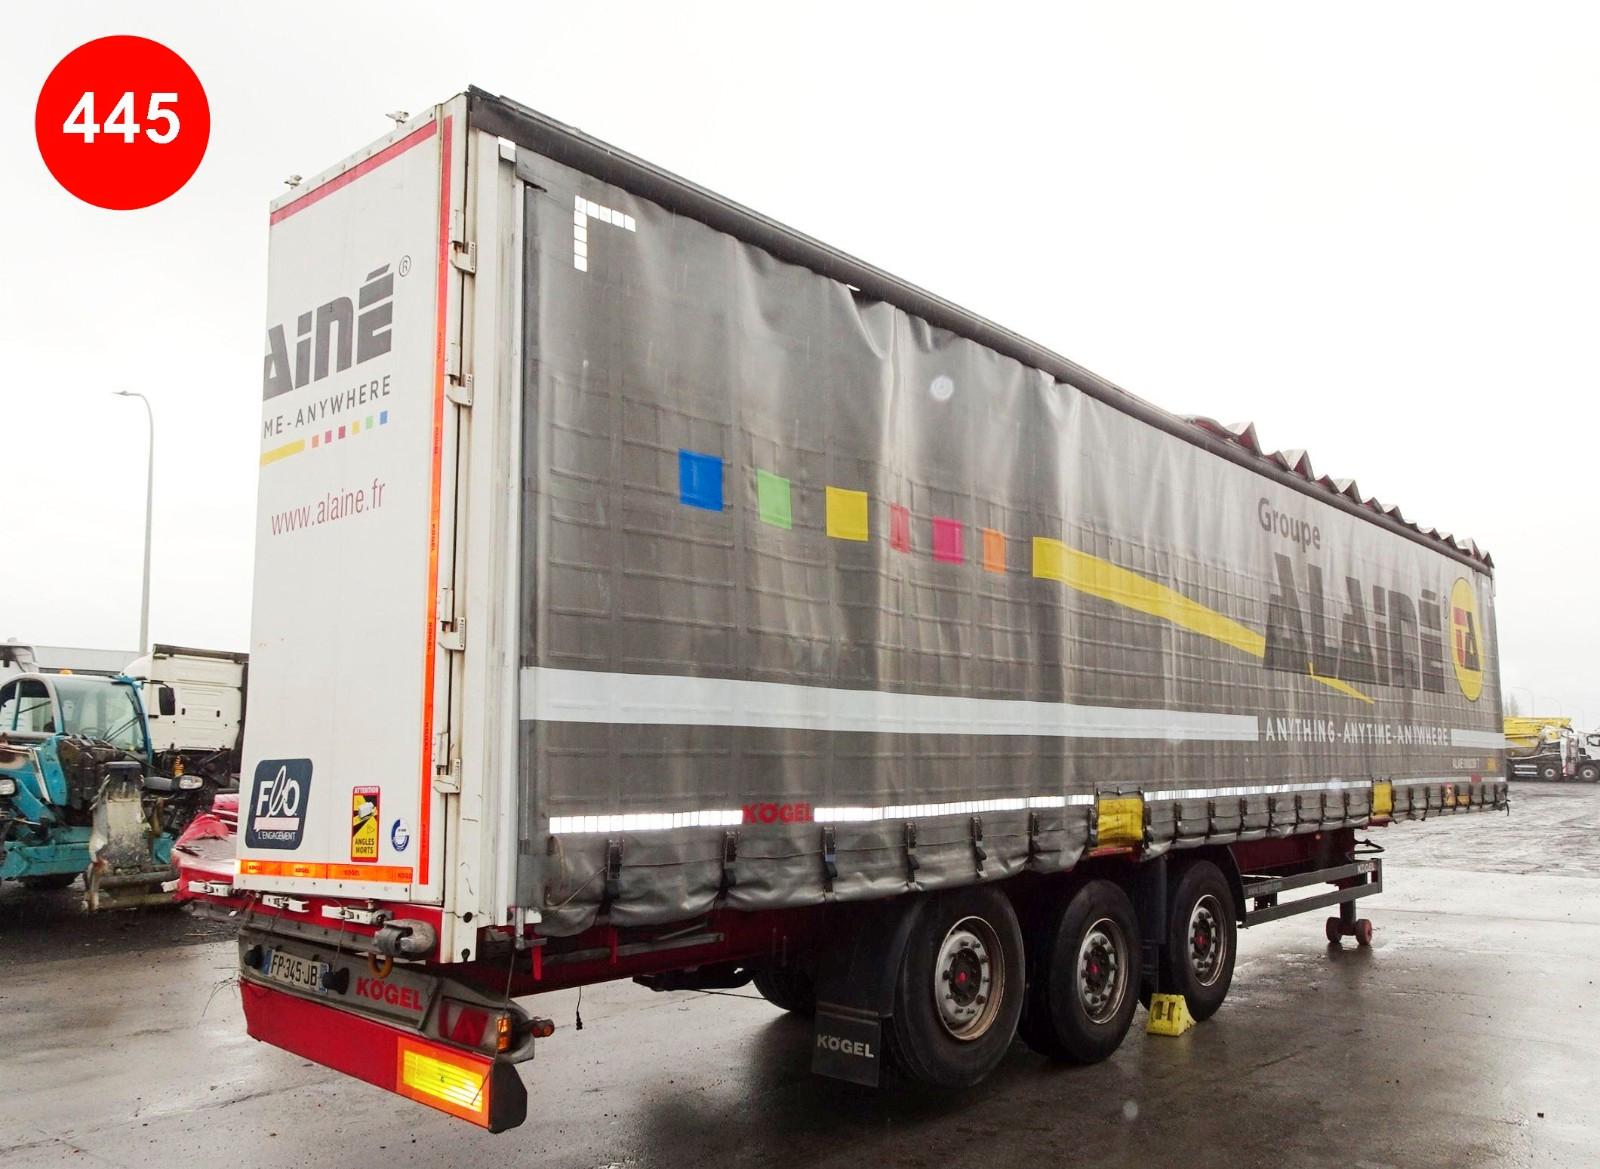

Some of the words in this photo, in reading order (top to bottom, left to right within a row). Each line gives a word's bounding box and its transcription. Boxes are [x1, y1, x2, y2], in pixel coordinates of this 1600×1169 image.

[271, 477, 386, 536] www.alaine.fr
[1257, 497, 1321, 553] Groupe
[355, 838, 375, 846] ANGLES
[355, 846, 374, 854] MORTS
[271, 954, 318, 986] FP-345-JB
[355, 975, 424, 1012] KÖGEL
[816, 1033, 875, 1058] KÖGEL
